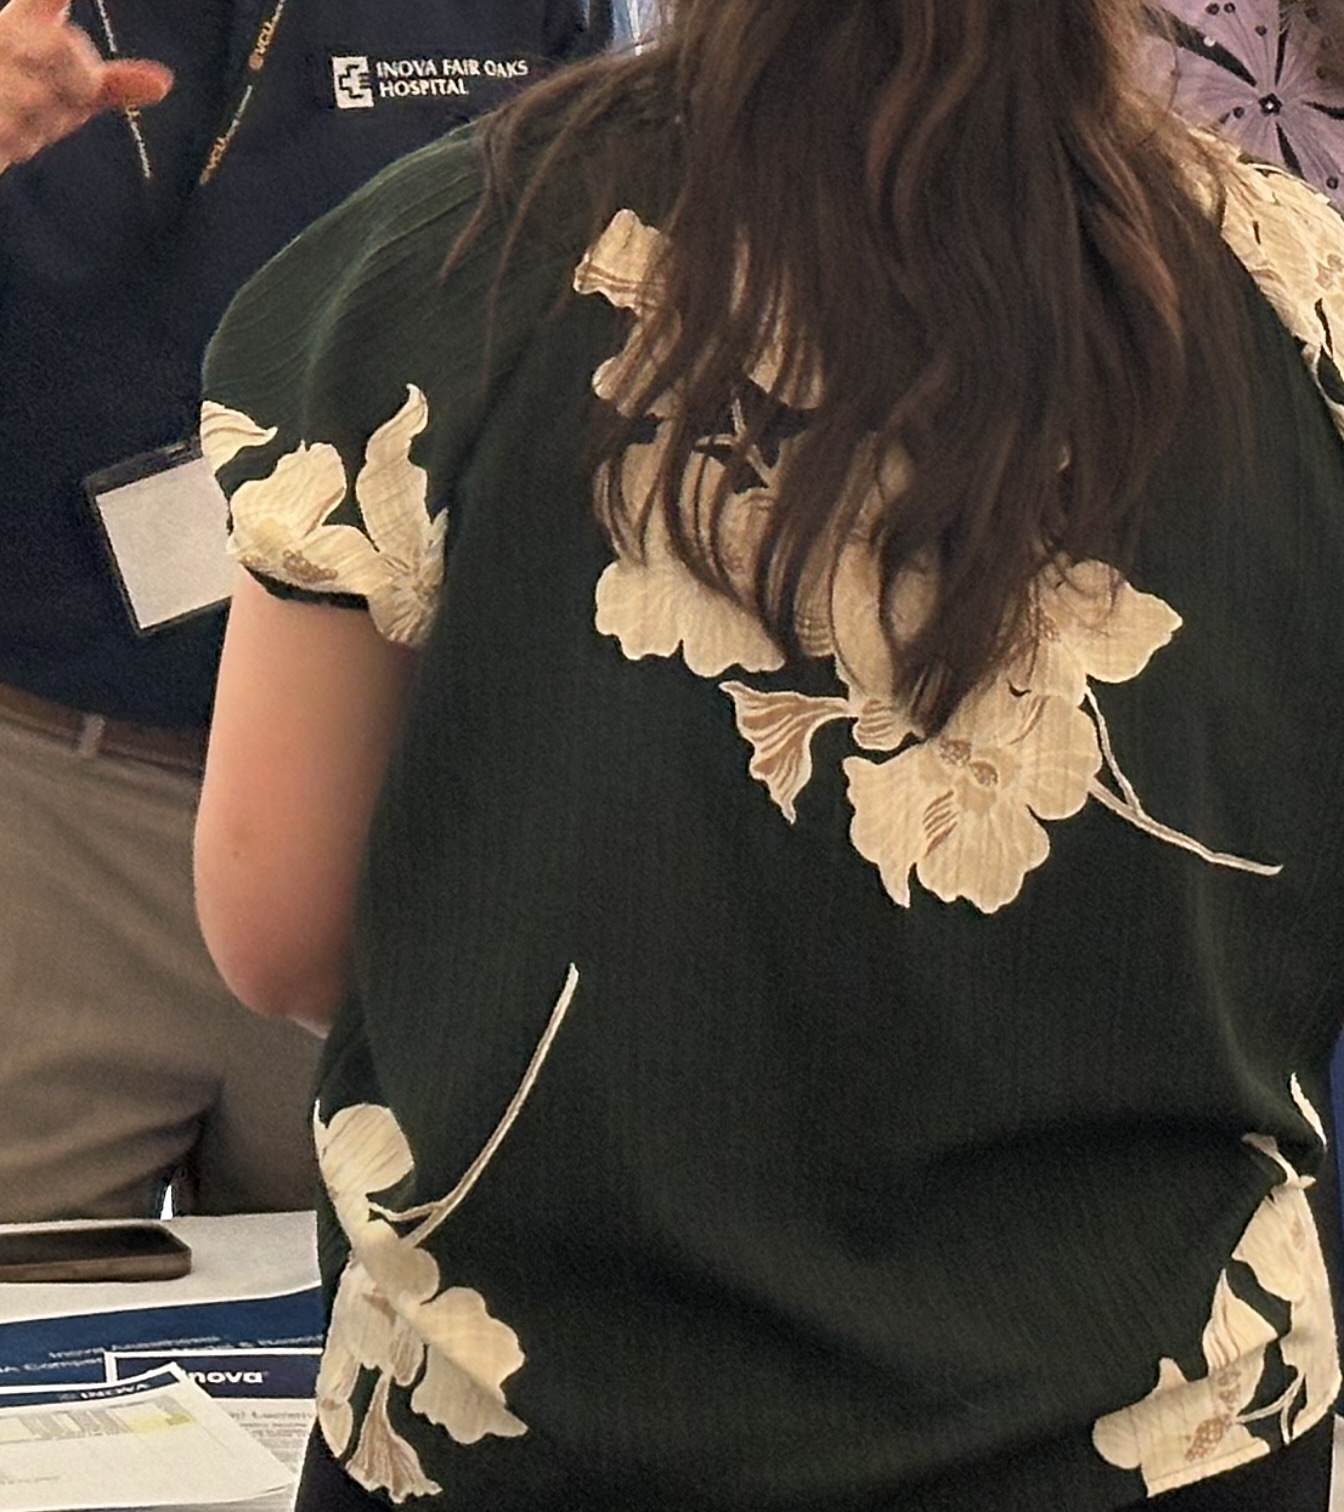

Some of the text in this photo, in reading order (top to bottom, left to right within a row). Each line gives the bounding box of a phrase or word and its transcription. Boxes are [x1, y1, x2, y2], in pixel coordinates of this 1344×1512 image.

[376, 58, 528, 78] INOVA FAIR OAKS
[379, 78, 469, 97] HOSPITAL
[189, 1371, 264, 1384] nova
